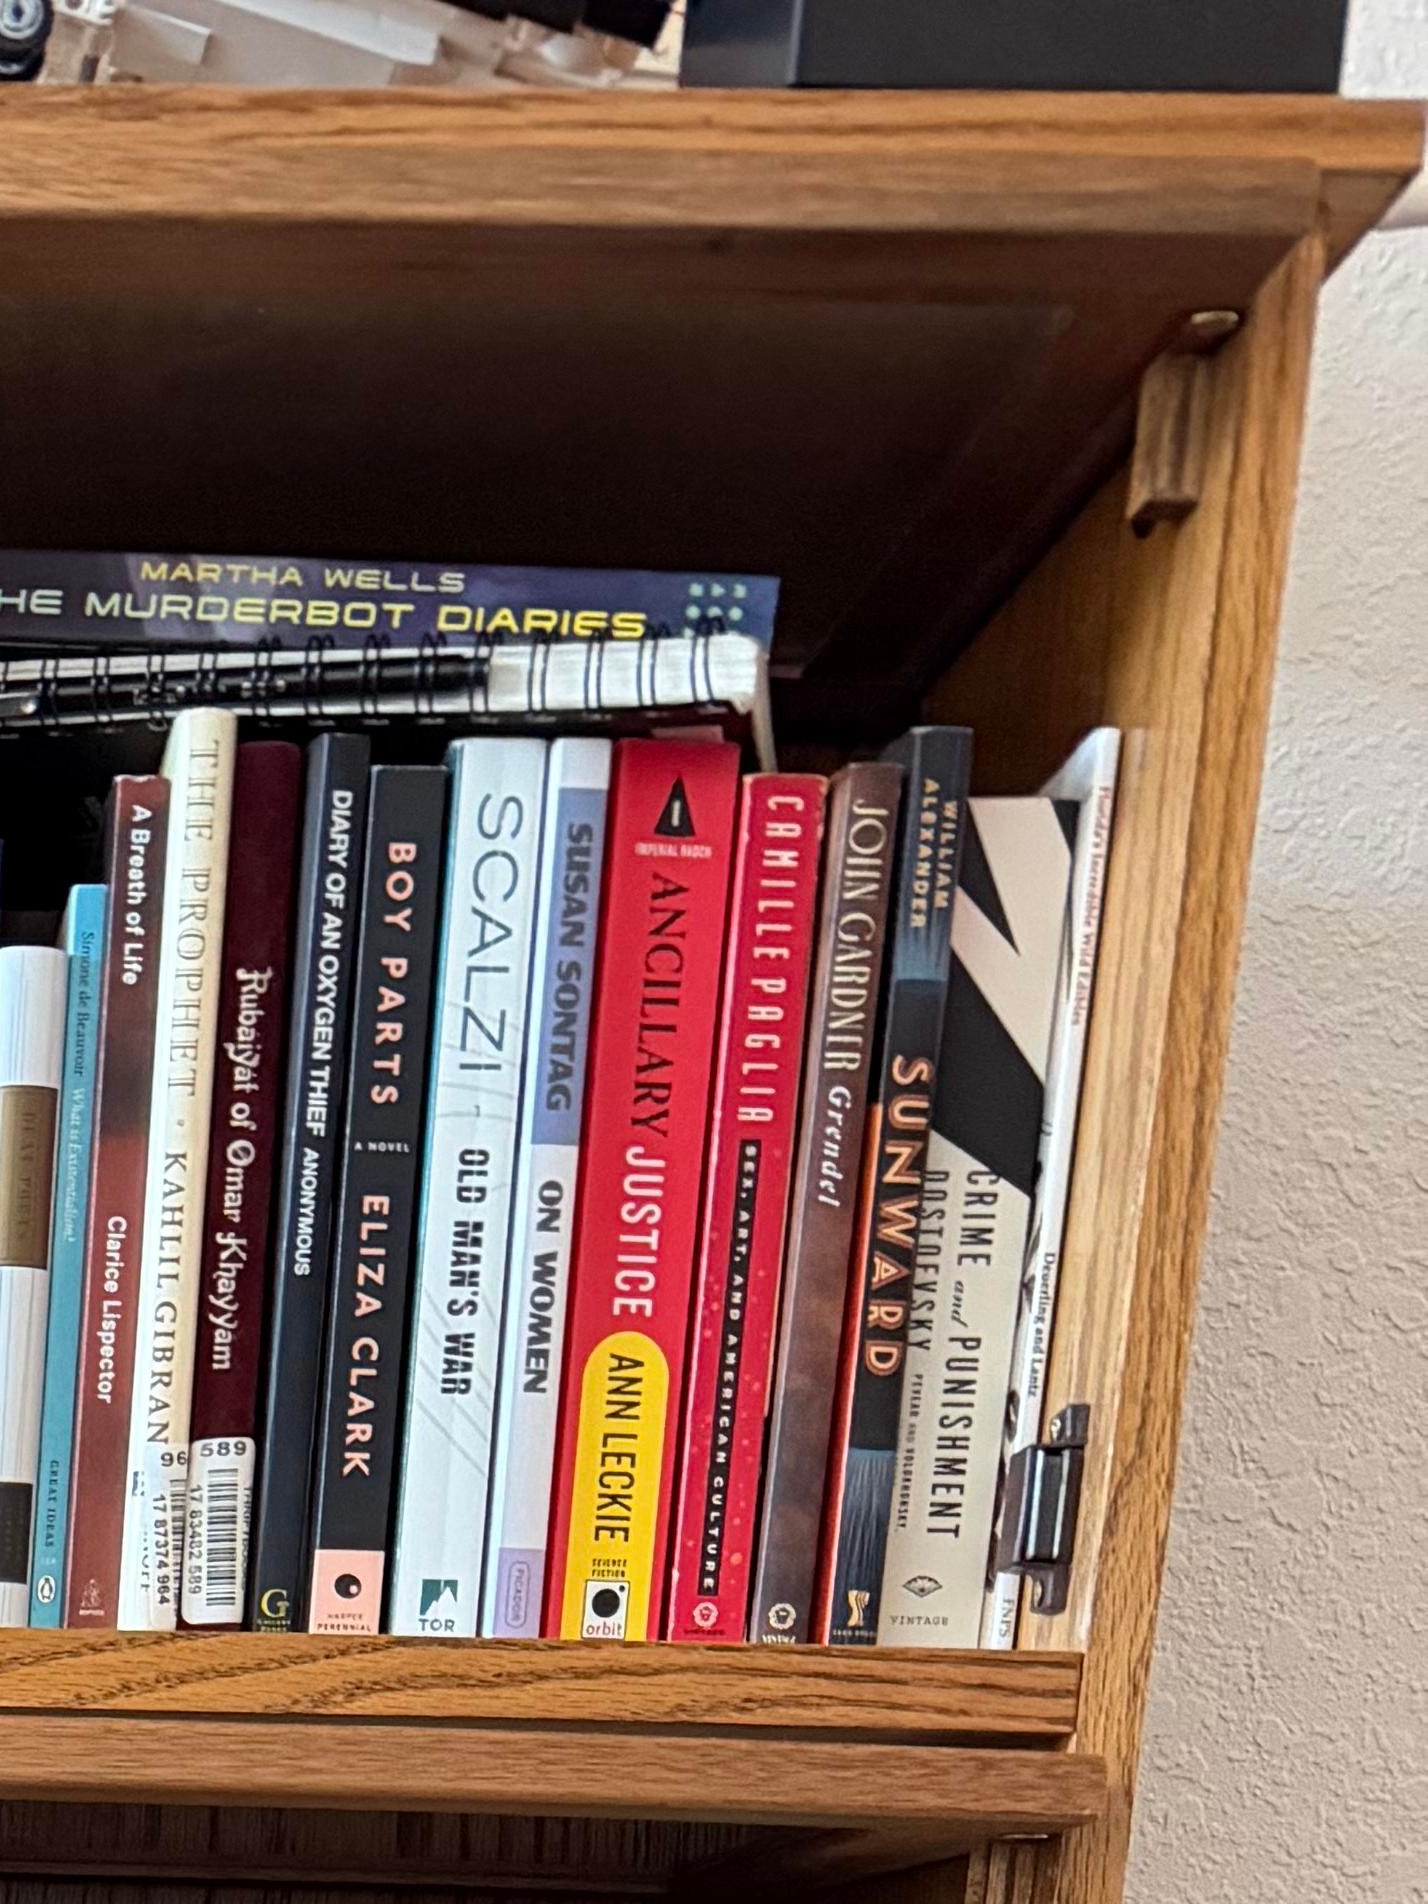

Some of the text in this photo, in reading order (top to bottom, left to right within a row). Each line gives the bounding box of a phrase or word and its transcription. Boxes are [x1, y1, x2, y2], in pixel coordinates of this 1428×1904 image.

[83, 594, 414, 629] MURDERBOT
[437, 602, 647, 639] DIARIES
[139, 561, 466, 593] MARTHA WELLS
[370, 841, 417, 1107] BOY PARTS
[611, 871, 688, 1319] ANCILLARY JUSTICE
[593, 1353, 644, 1544] ANN LECKIE
[585, 1620, 622, 1637] orbit
